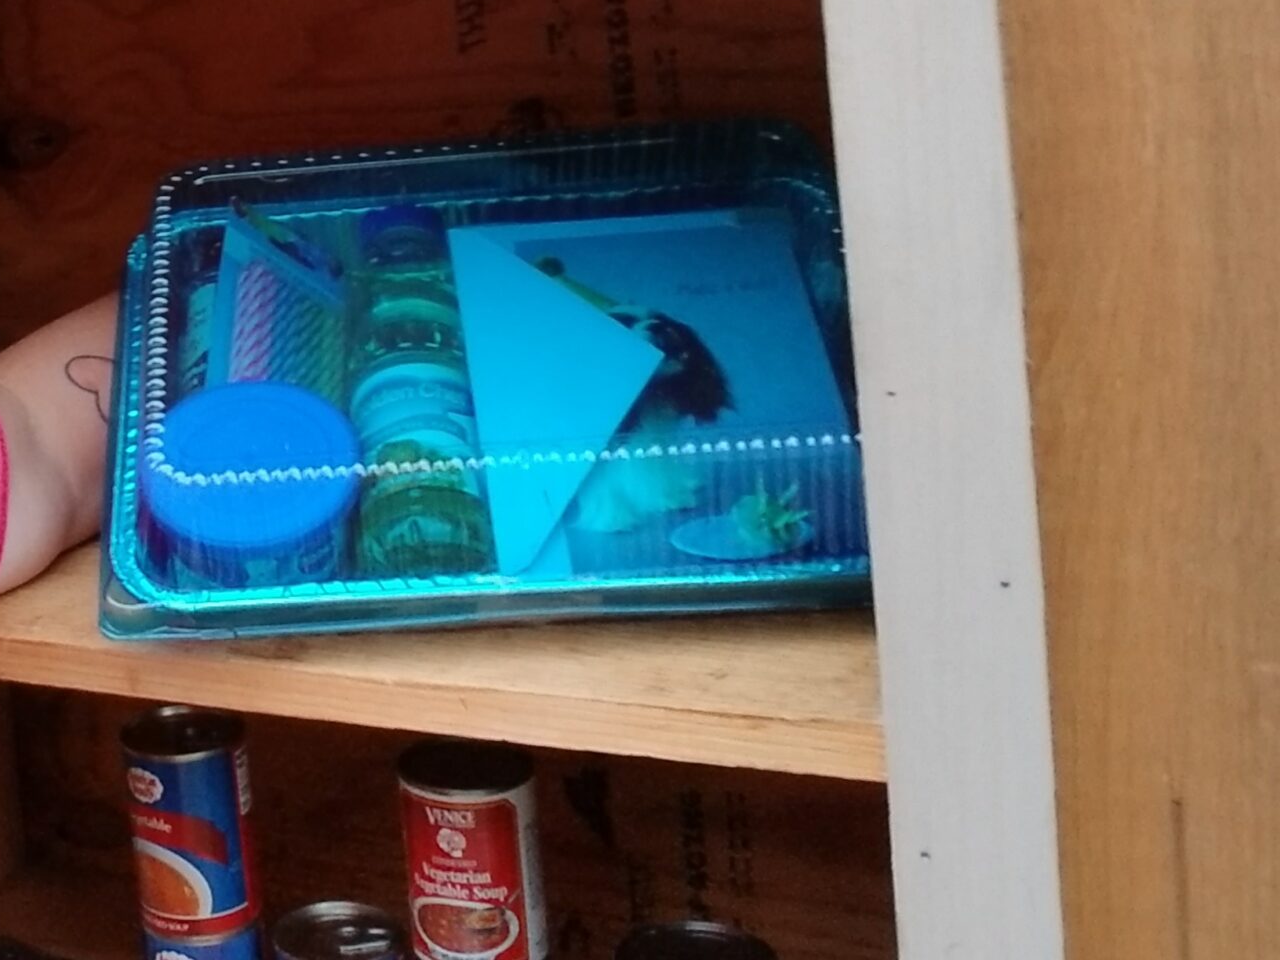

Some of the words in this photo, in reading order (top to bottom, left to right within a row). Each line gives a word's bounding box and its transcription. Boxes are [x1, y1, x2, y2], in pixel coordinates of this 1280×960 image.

[424, 805, 477, 830] VENICE
[421, 860, 493, 885] Vegetarian
[472, 885, 509, 903] Soup
